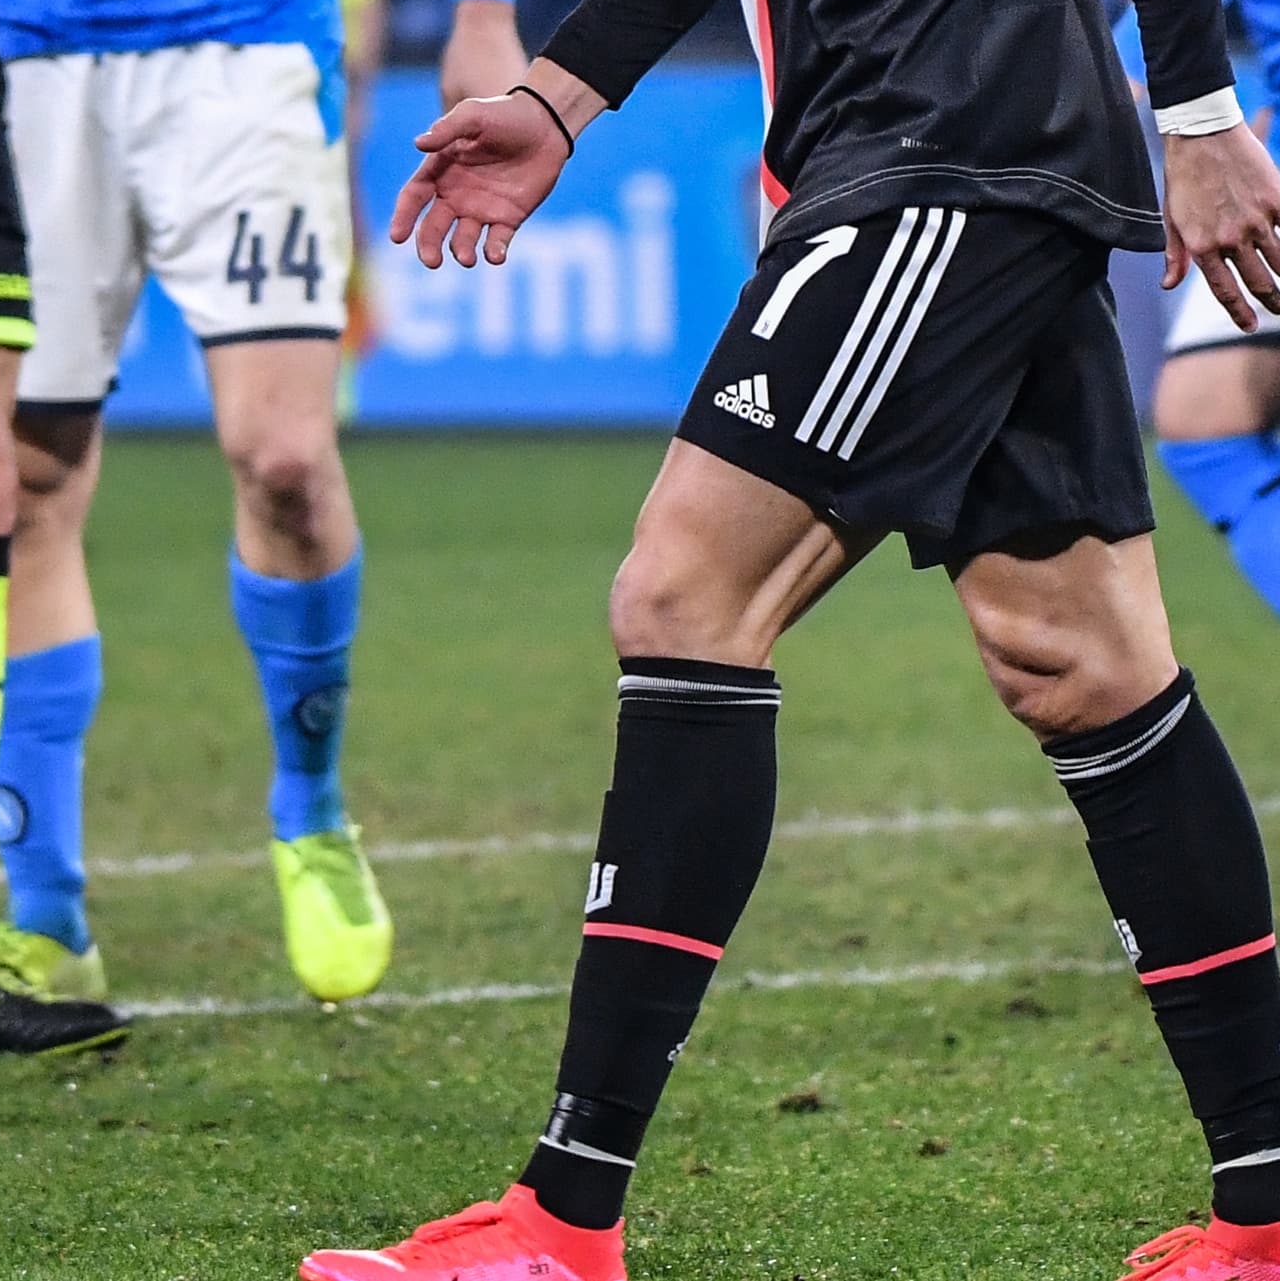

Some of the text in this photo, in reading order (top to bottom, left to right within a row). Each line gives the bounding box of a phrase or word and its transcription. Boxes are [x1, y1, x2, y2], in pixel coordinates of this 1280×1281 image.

[227, 205, 324, 304] 44
[375, 173, 677, 358] emi
[751, 224, 859, 340] 7
[713, 391, 777, 430] adidas
